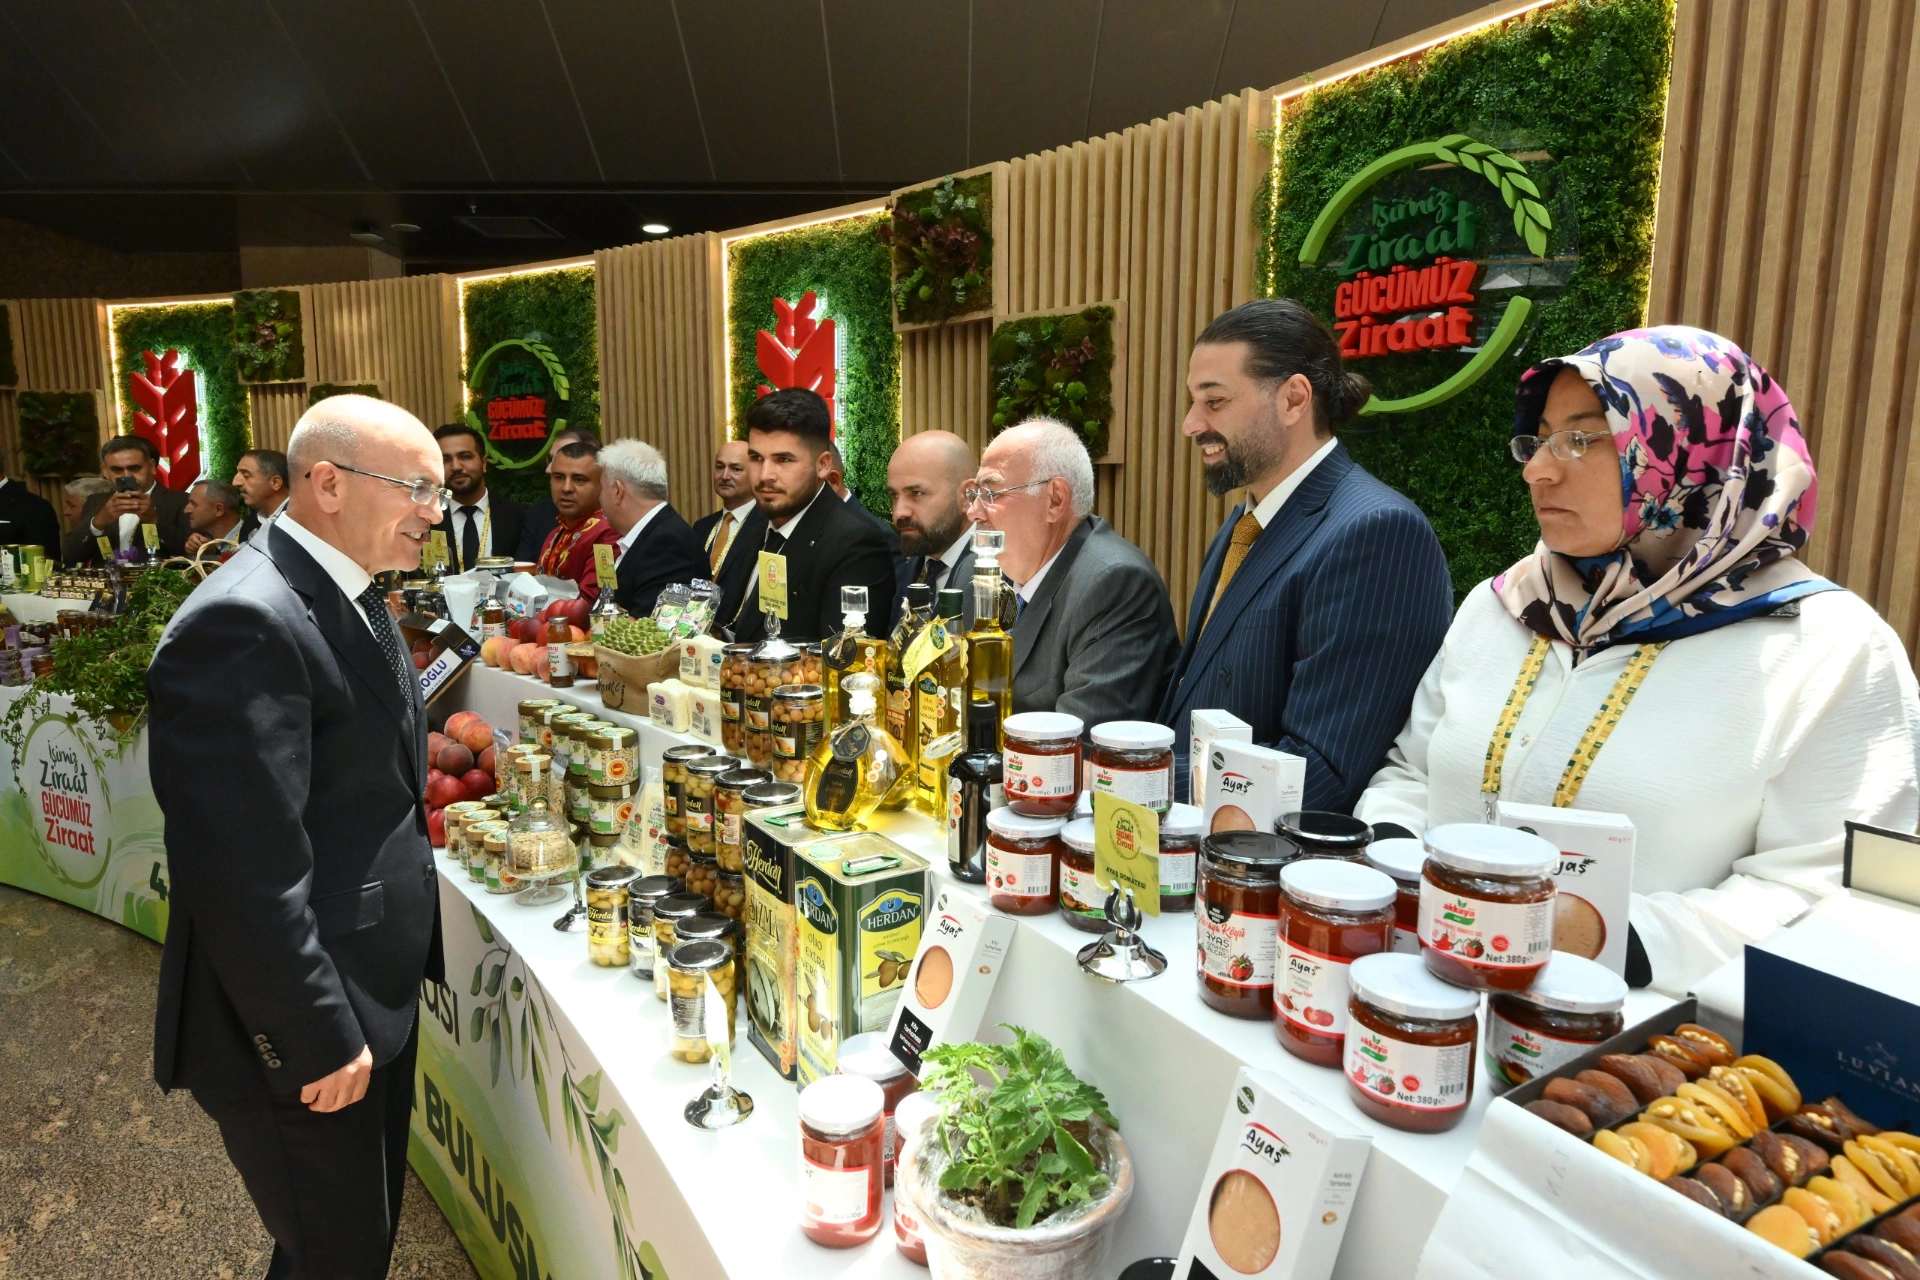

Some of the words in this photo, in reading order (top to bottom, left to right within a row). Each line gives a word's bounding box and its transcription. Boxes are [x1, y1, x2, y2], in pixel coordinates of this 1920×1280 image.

[1337, 200, 1482, 276] Ziraat
[1335, 257, 1478, 319] GÜCÜMÜZ
[1334, 306, 1473, 360] Ziraat
[487, 395, 546, 419] GÜCÜMÜZ
[488, 420, 547, 440] Ziraat
[39, 759, 88, 795] Ziraat
[41, 788, 93, 828] GÜCÜMÜZ
[44, 817, 96, 856] Ziraat
[1116, 840, 1134, 851] Ziraat
[1106, 866, 1119, 877] AYAŞ
[867, 906, 916, 930] HERDAN
[1443, 902, 1475, 918] akkaya
[1221, 922, 1247, 942] Köyü
[1486, 953, 1505, 963] Net:
[1506, 955, 1527, 965] 380g
[1360, 1036, 1388, 1056] akkaya
[1397, 1091, 1415, 1102] Net:
[1417, 1094, 1438, 1106] 380g
[1240, 1128, 1283, 1165] Ayaş
